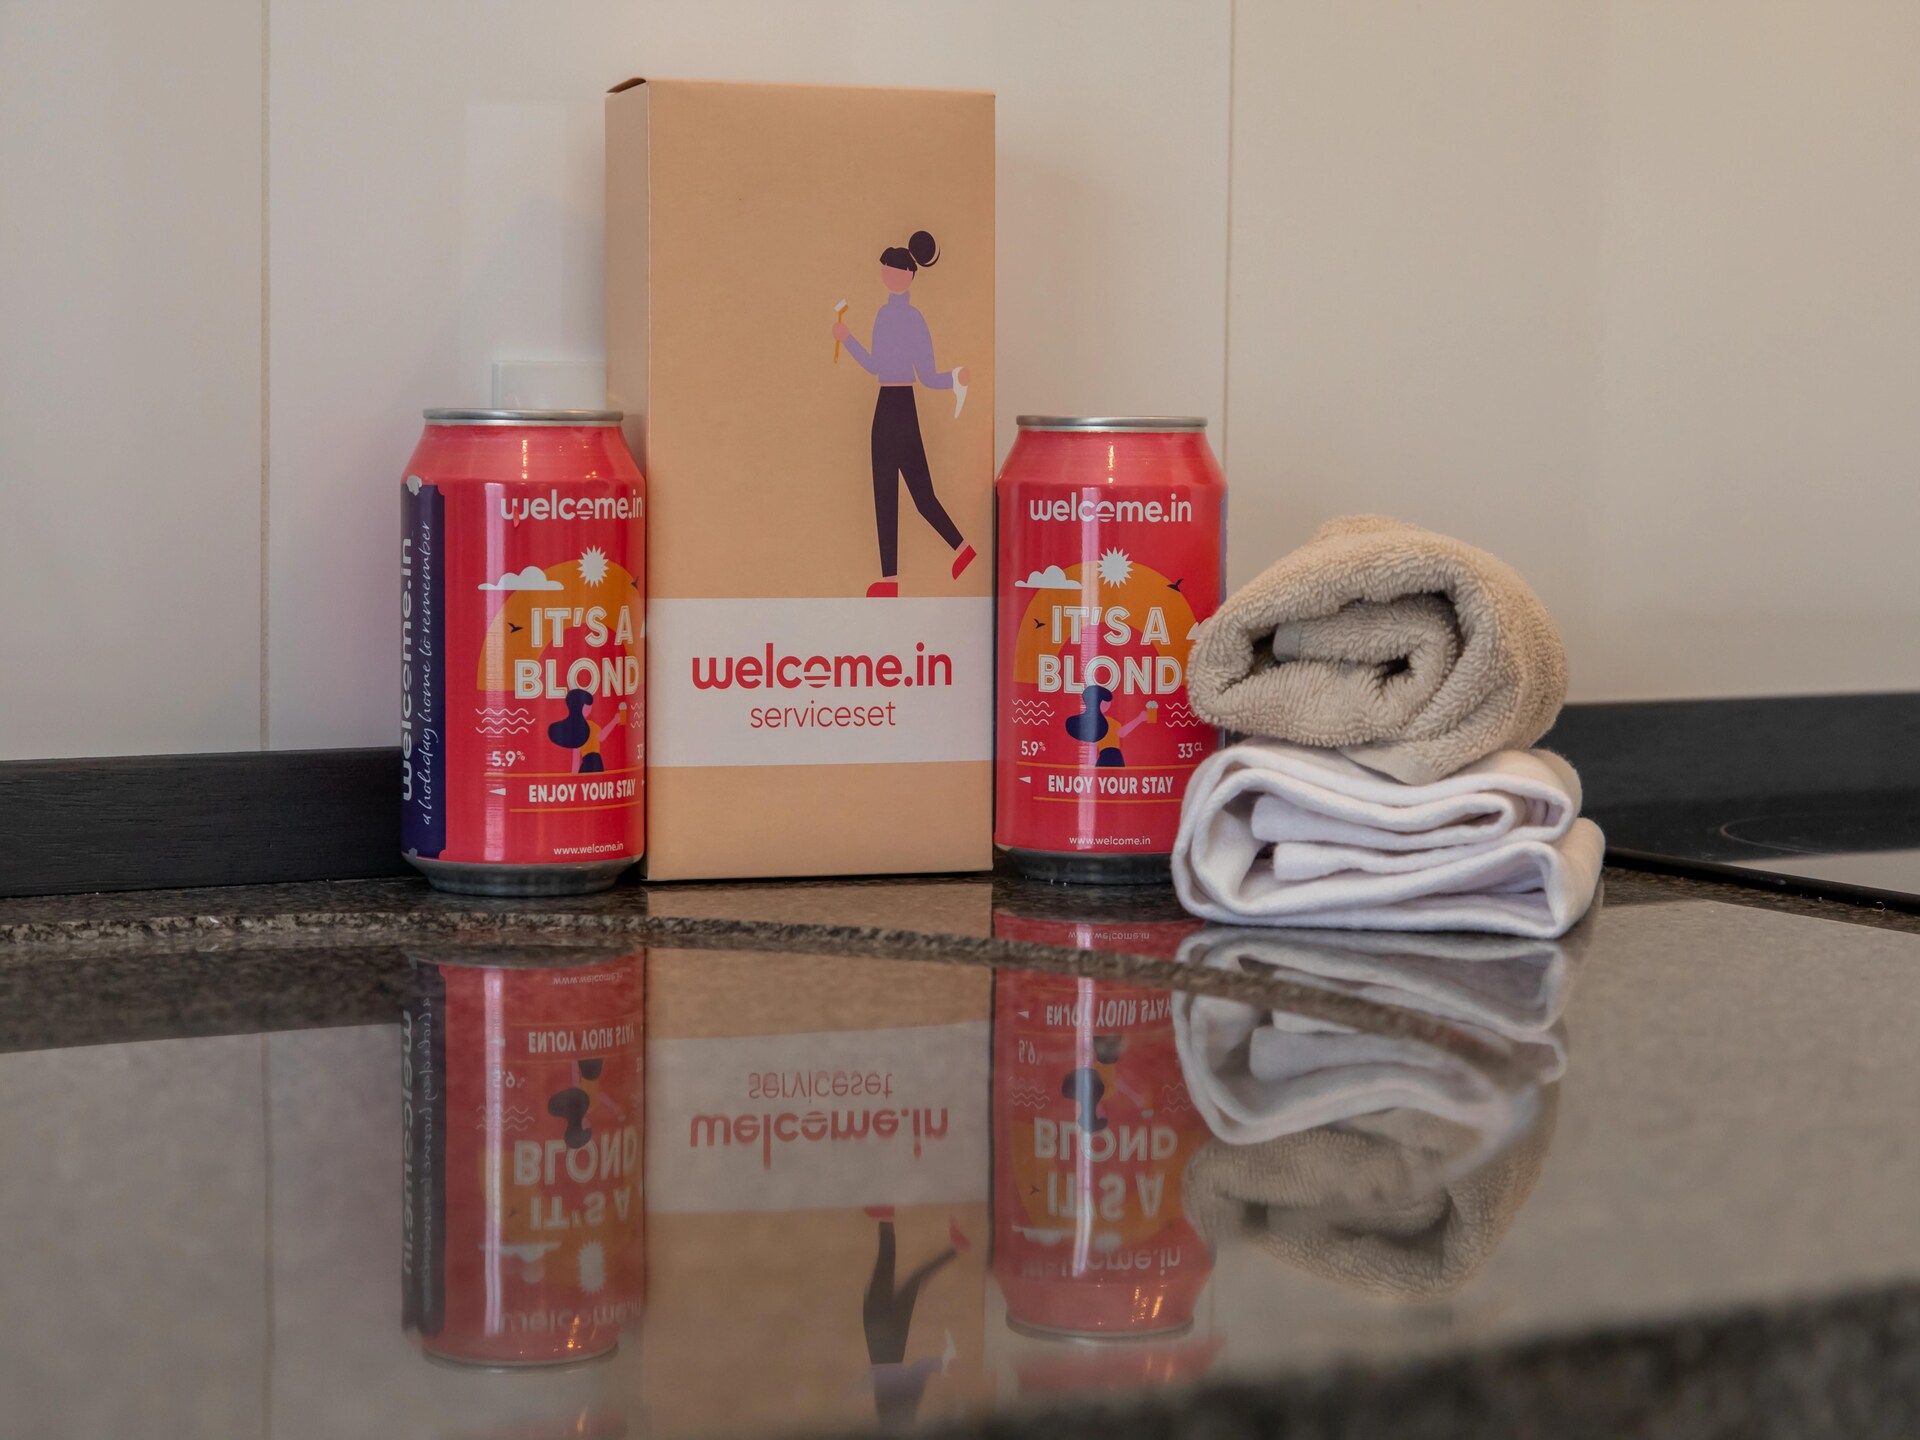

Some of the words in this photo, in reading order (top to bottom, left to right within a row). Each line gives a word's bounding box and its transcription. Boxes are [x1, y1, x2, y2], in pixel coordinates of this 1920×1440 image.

[500, 489, 643, 520] welcome.in
[1030, 492, 1192, 523] welcome.in
[418, 521, 432, 633] remember
[531, 606, 608, 648] IT'S
[614, 605, 634, 646] A
[1052, 605, 1131, 646] IT'S
[1140, 606, 1171, 645] A
[402, 537, 412, 801] welcome.in
[514, 655, 641, 699] BLOND
[692, 642, 953, 690] welcome.in
[1038, 654, 1182, 694] BLOND
[417, 660, 432, 723] home
[750, 700, 896, 728] serviceset
[491, 751, 526, 767] 5.9%
[1021, 740, 1046, 756] 5.9%
[417, 727, 439, 810] holiday
[528, 782, 578, 802] ENJOY
[581, 781, 614, 800] YOUR
[616, 779, 636, 797] STAY
[1048, 775, 1094, 793] ENJOY
[1098, 777, 1138, 794] YOUR
[1142, 776, 1174, 794] STAY
[423, 815, 432, 825] a
[553, 841, 624, 855] www.welcome.in
[1069, 836, 1151, 846] www.welcome.in
